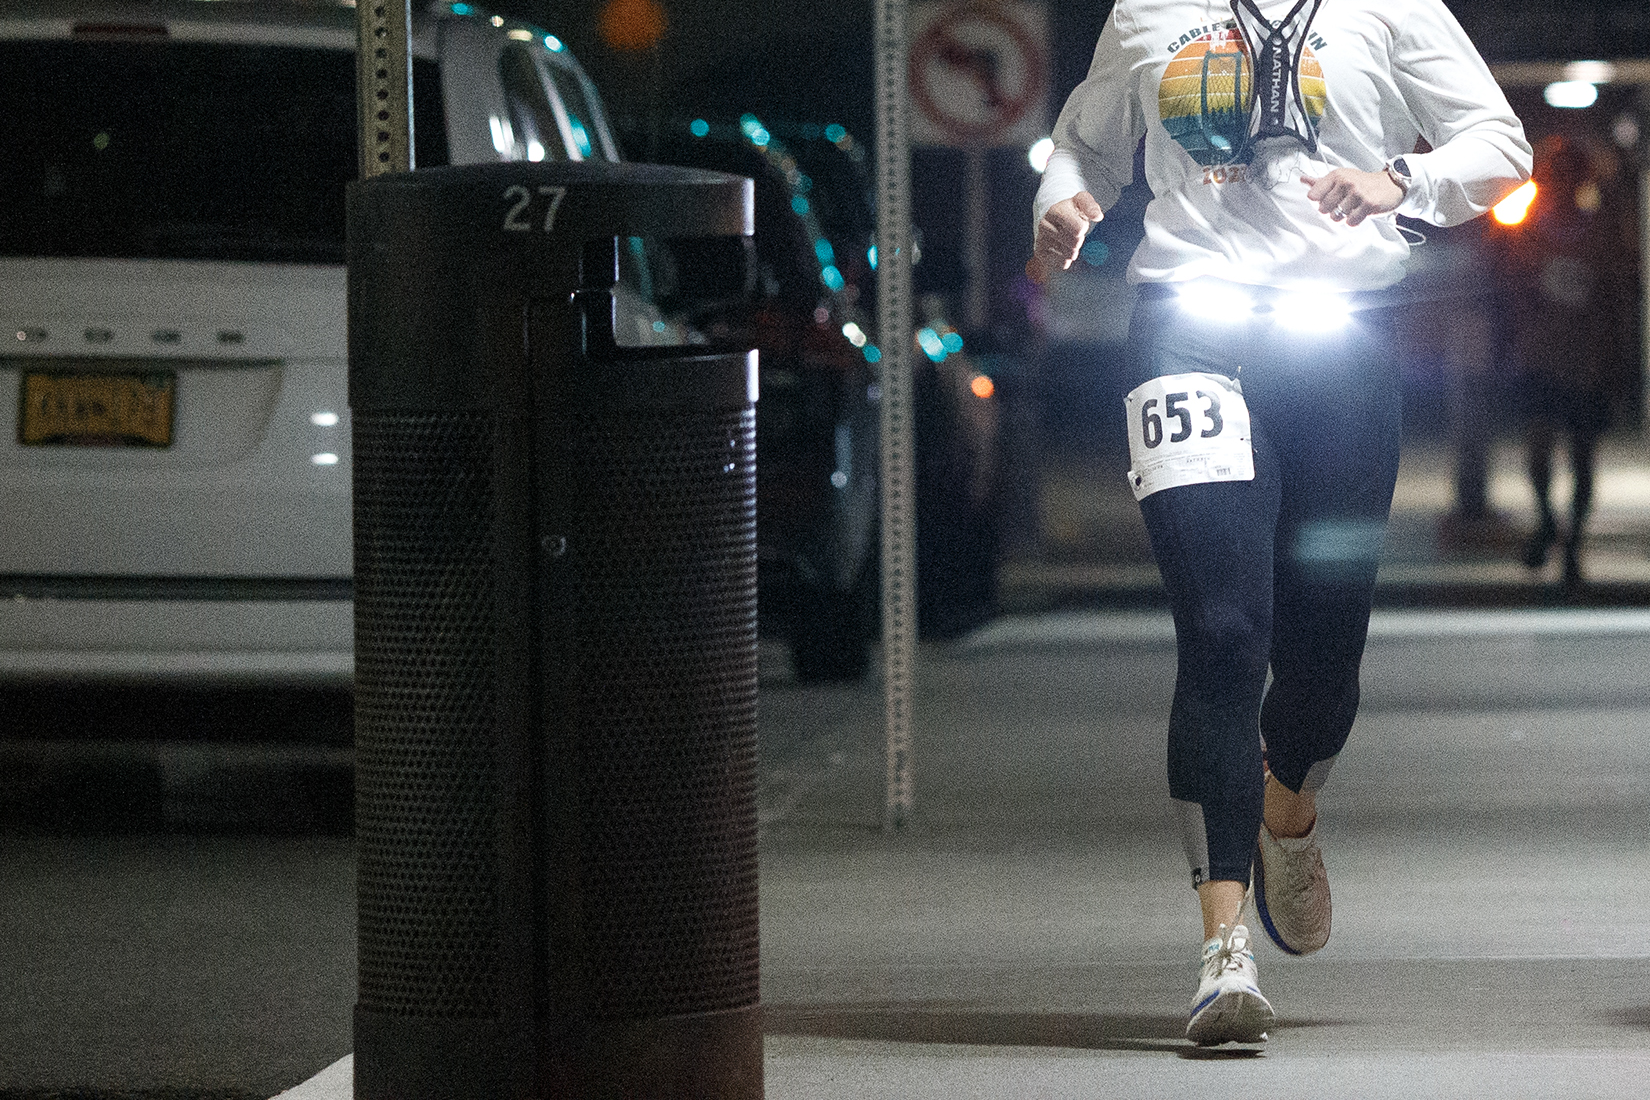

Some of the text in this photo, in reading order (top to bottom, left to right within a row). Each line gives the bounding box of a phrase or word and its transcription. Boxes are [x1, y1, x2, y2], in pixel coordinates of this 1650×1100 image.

[1167, 22, 1221, 53] CABLE
[503, 185, 568, 232] 27
[1141, 390, 1224, 449] 653
